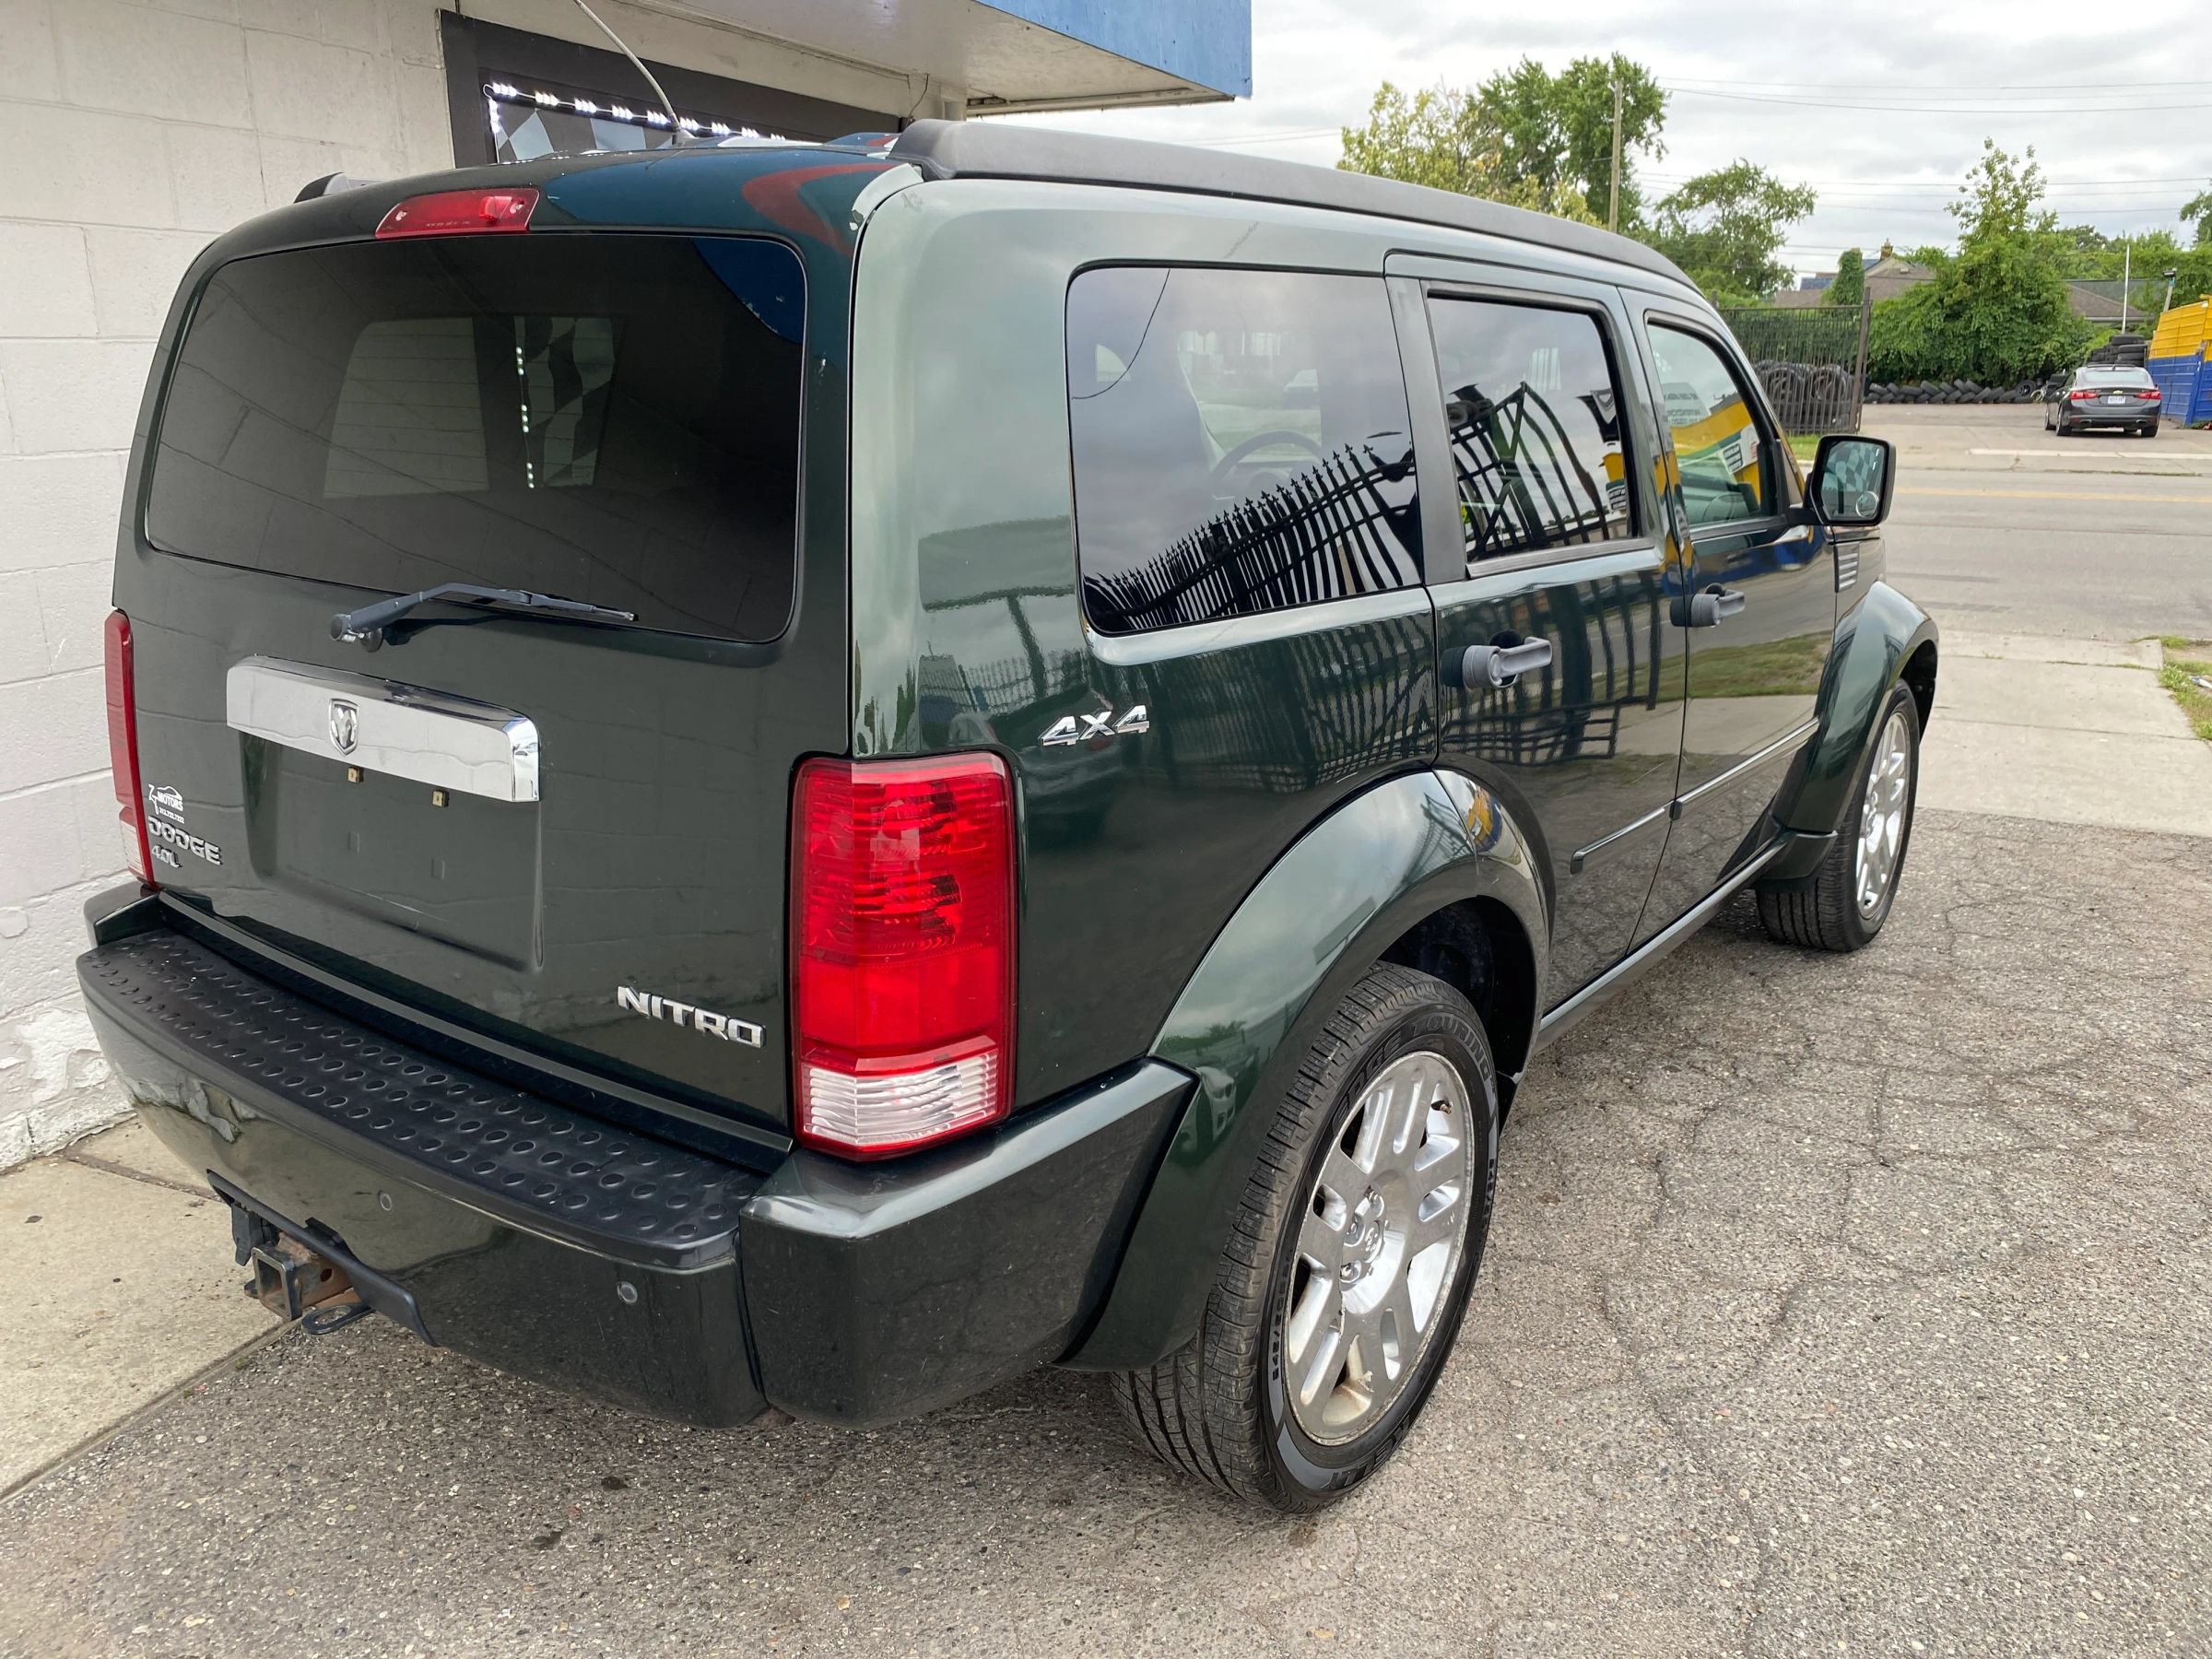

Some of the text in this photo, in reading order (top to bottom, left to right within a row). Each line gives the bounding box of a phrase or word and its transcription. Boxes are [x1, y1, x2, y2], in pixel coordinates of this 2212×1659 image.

[157, 791, 184, 812] MOTORS
[147, 815, 223, 866] DODGE
[618, 985, 767, 1049] NITRO
[1332, 1015, 1491, 1135] EDGE TOURING
